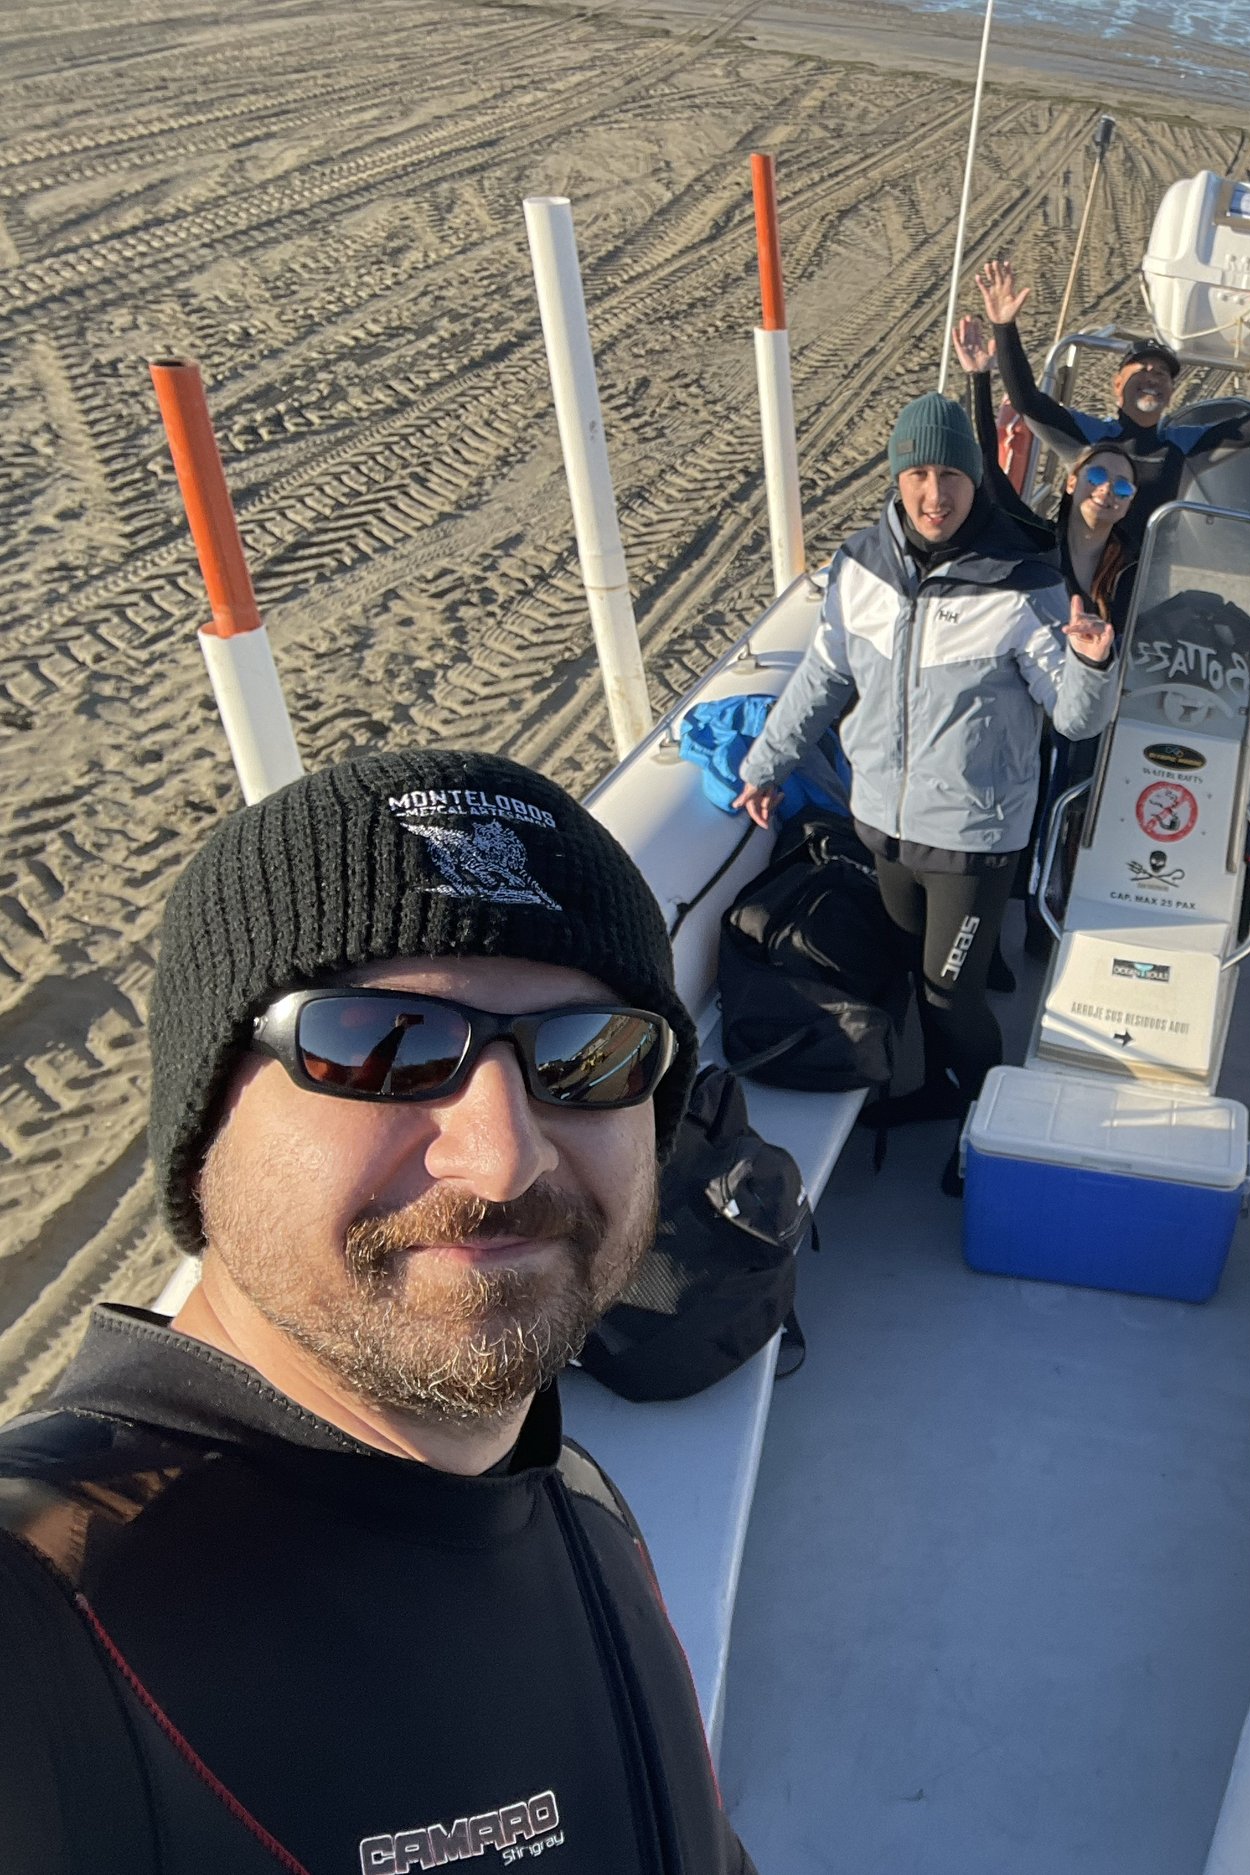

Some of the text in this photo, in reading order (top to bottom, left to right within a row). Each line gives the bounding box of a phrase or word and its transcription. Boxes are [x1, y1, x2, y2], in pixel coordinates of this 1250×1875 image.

[388, 789, 556, 828] MONTELOBOS
[1135, 895, 1158, 905] MAX
[1160, 898, 1173, 908] 25
[1175, 901, 1196, 910] PAX
[1071, 1001, 1104, 1020] ARROJE
[1105, 1008, 1123, 1024] SUS
[1125, 1012, 1167, 1031] RESIDUOS
[359, 1790, 559, 1875] CAMARO
[502, 1829, 565, 1866] Stingray
